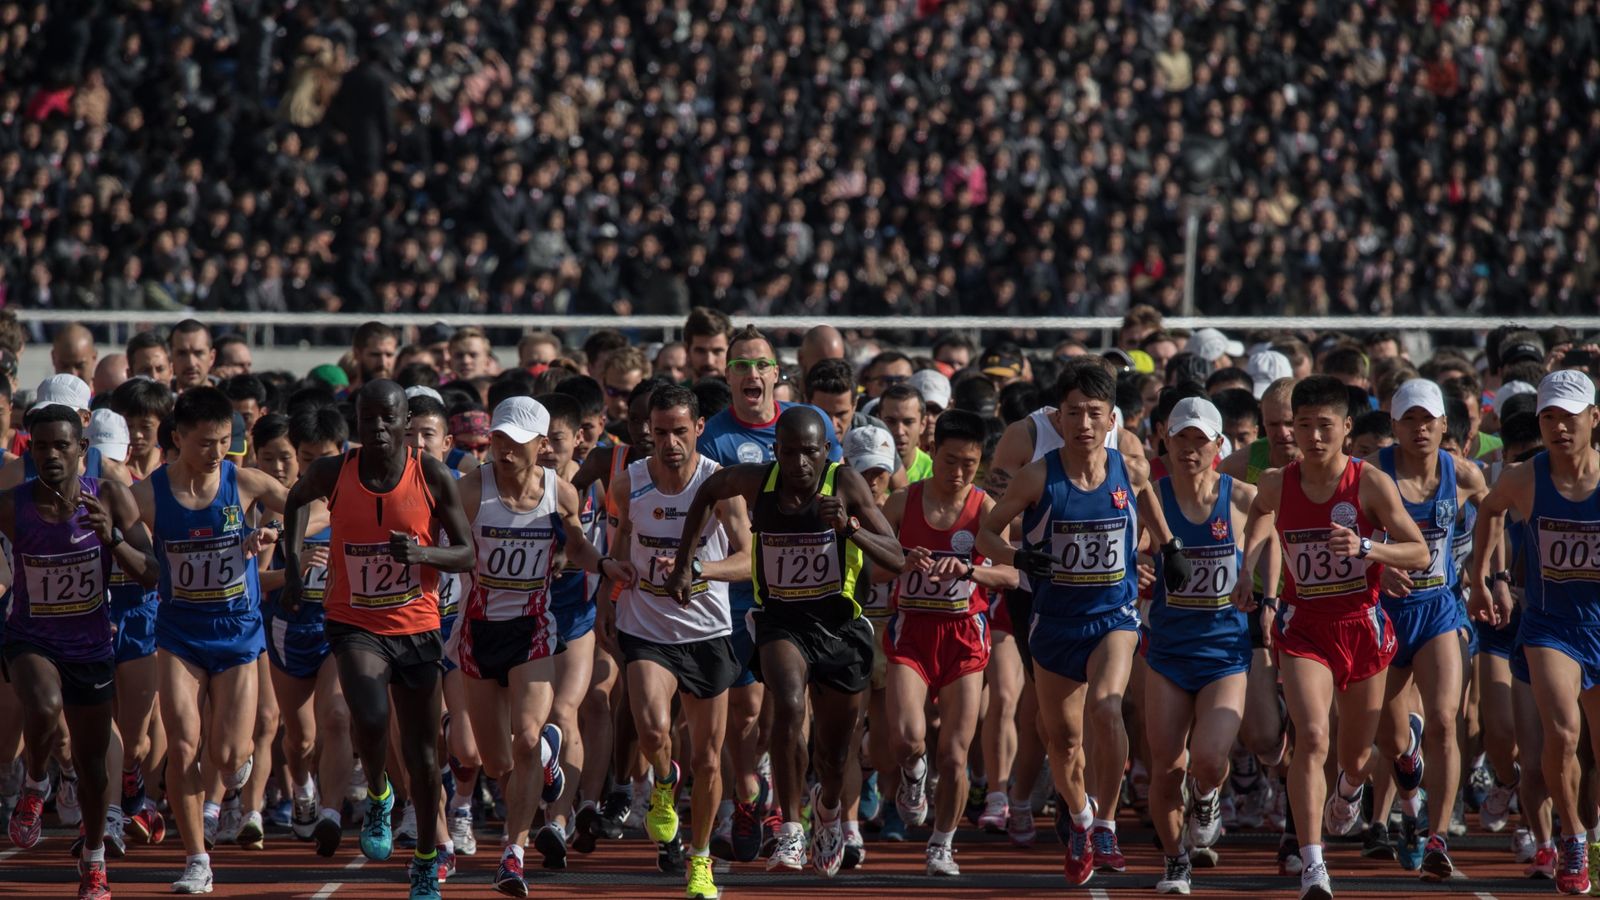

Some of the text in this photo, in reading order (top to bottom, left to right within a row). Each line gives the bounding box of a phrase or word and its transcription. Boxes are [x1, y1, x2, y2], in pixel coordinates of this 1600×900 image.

[487, 547, 544, 577] 001
[776, 553, 829, 584] 129
[1061, 539, 1118, 569] 035
[1296, 551, 1353, 582] 033
[39, 569, 95, 601] 125
[179, 556, 234, 587] 015
[360, 563, 411, 593] 124
